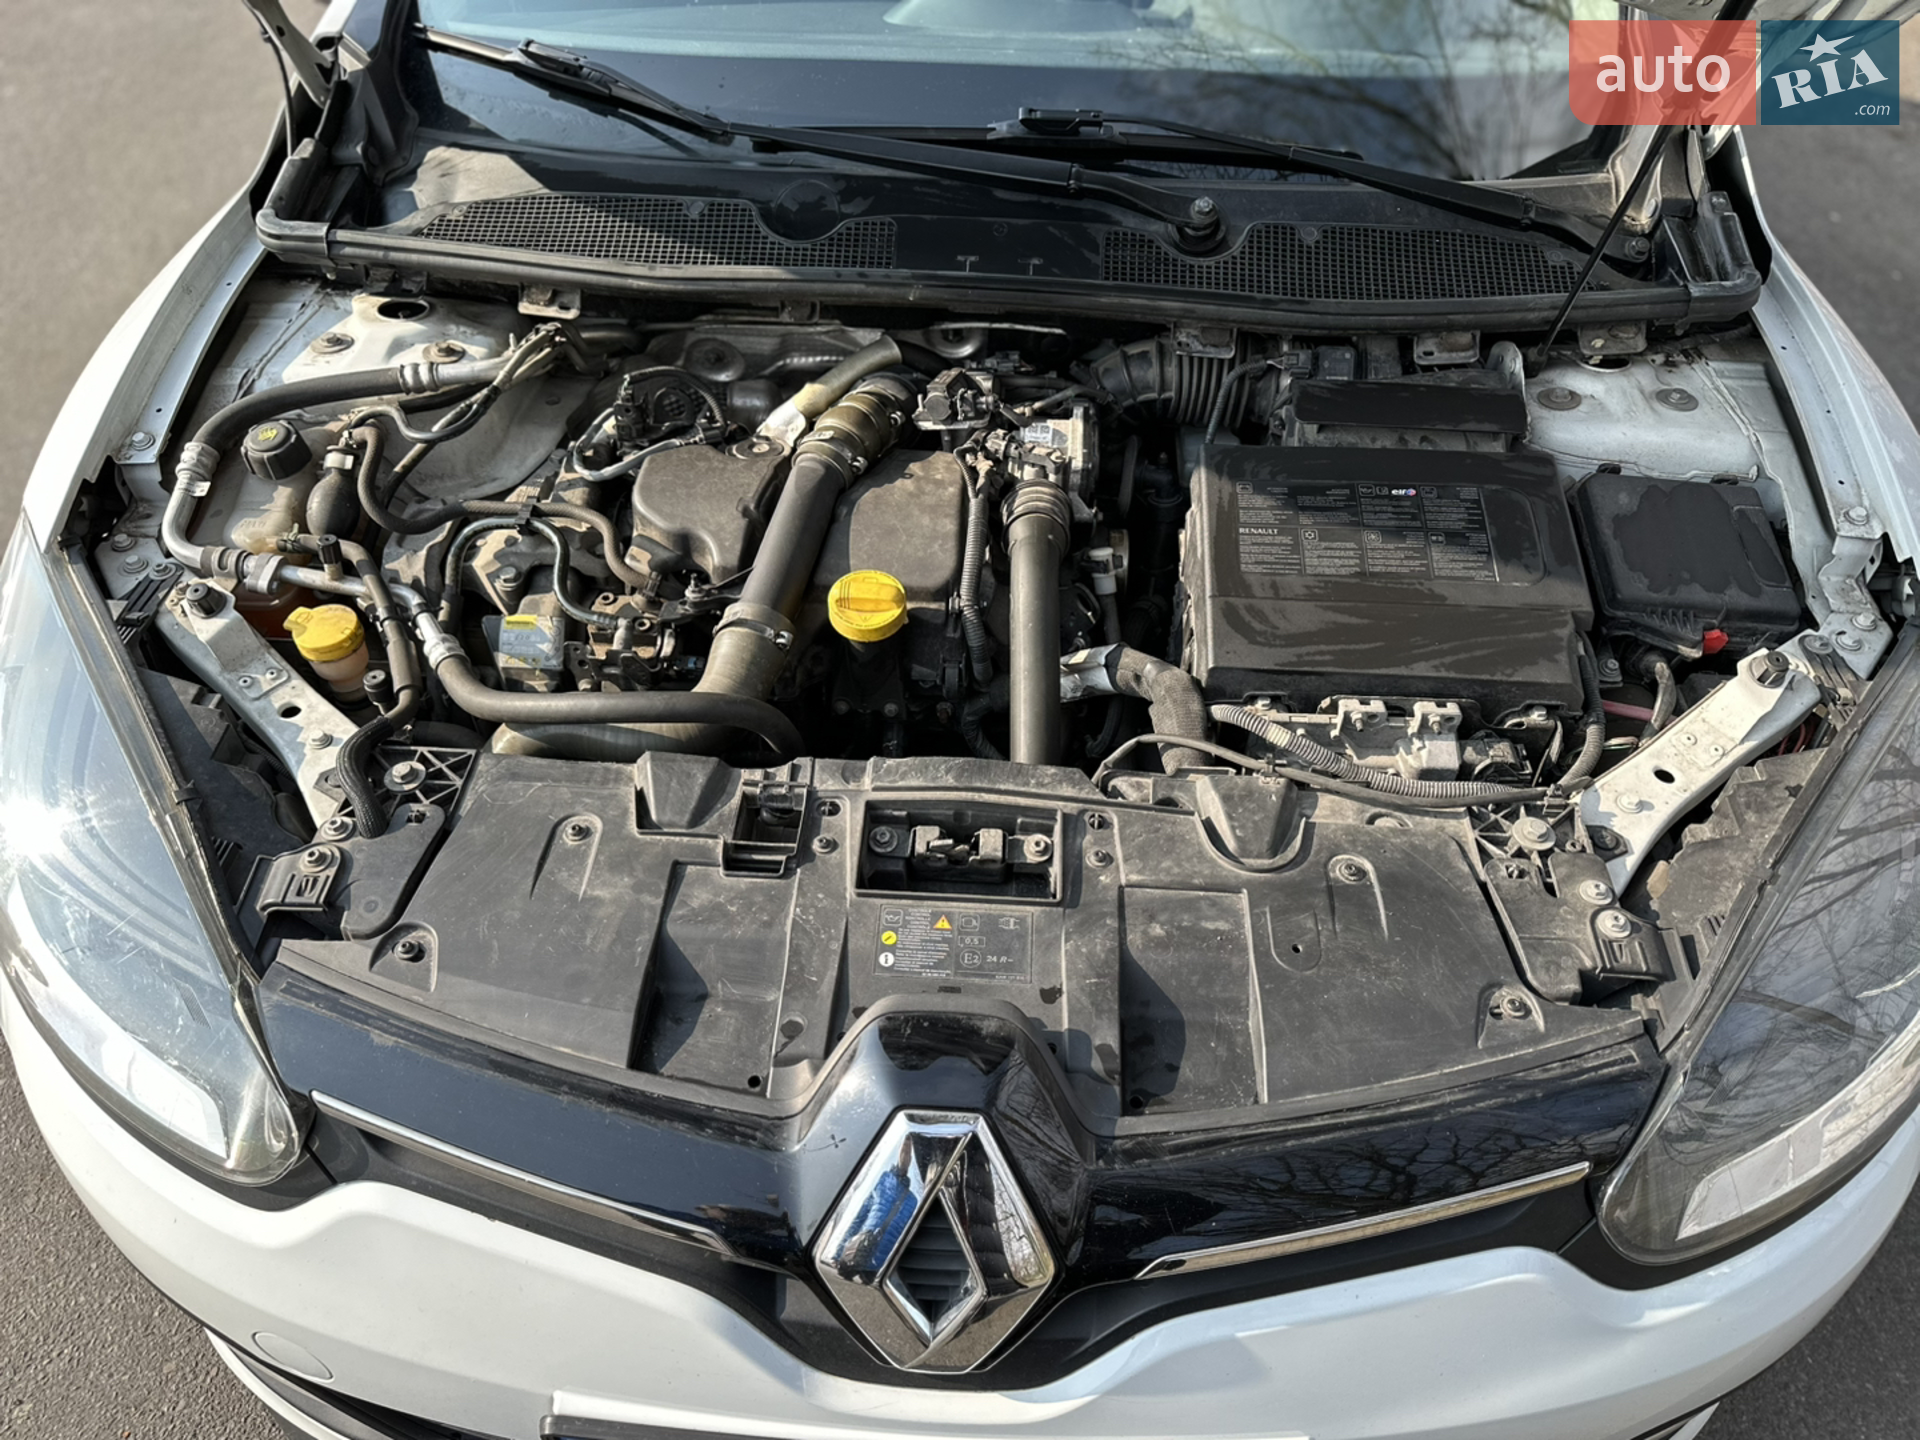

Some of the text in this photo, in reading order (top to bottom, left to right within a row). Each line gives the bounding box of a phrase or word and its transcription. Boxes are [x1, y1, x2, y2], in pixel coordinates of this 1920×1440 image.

[1391, 488, 1406, 496] elf
[1239, 527, 1279, 535] RENAULT
[964, 952, 980, 964] E2
[986, 955, 997, 963] 24
